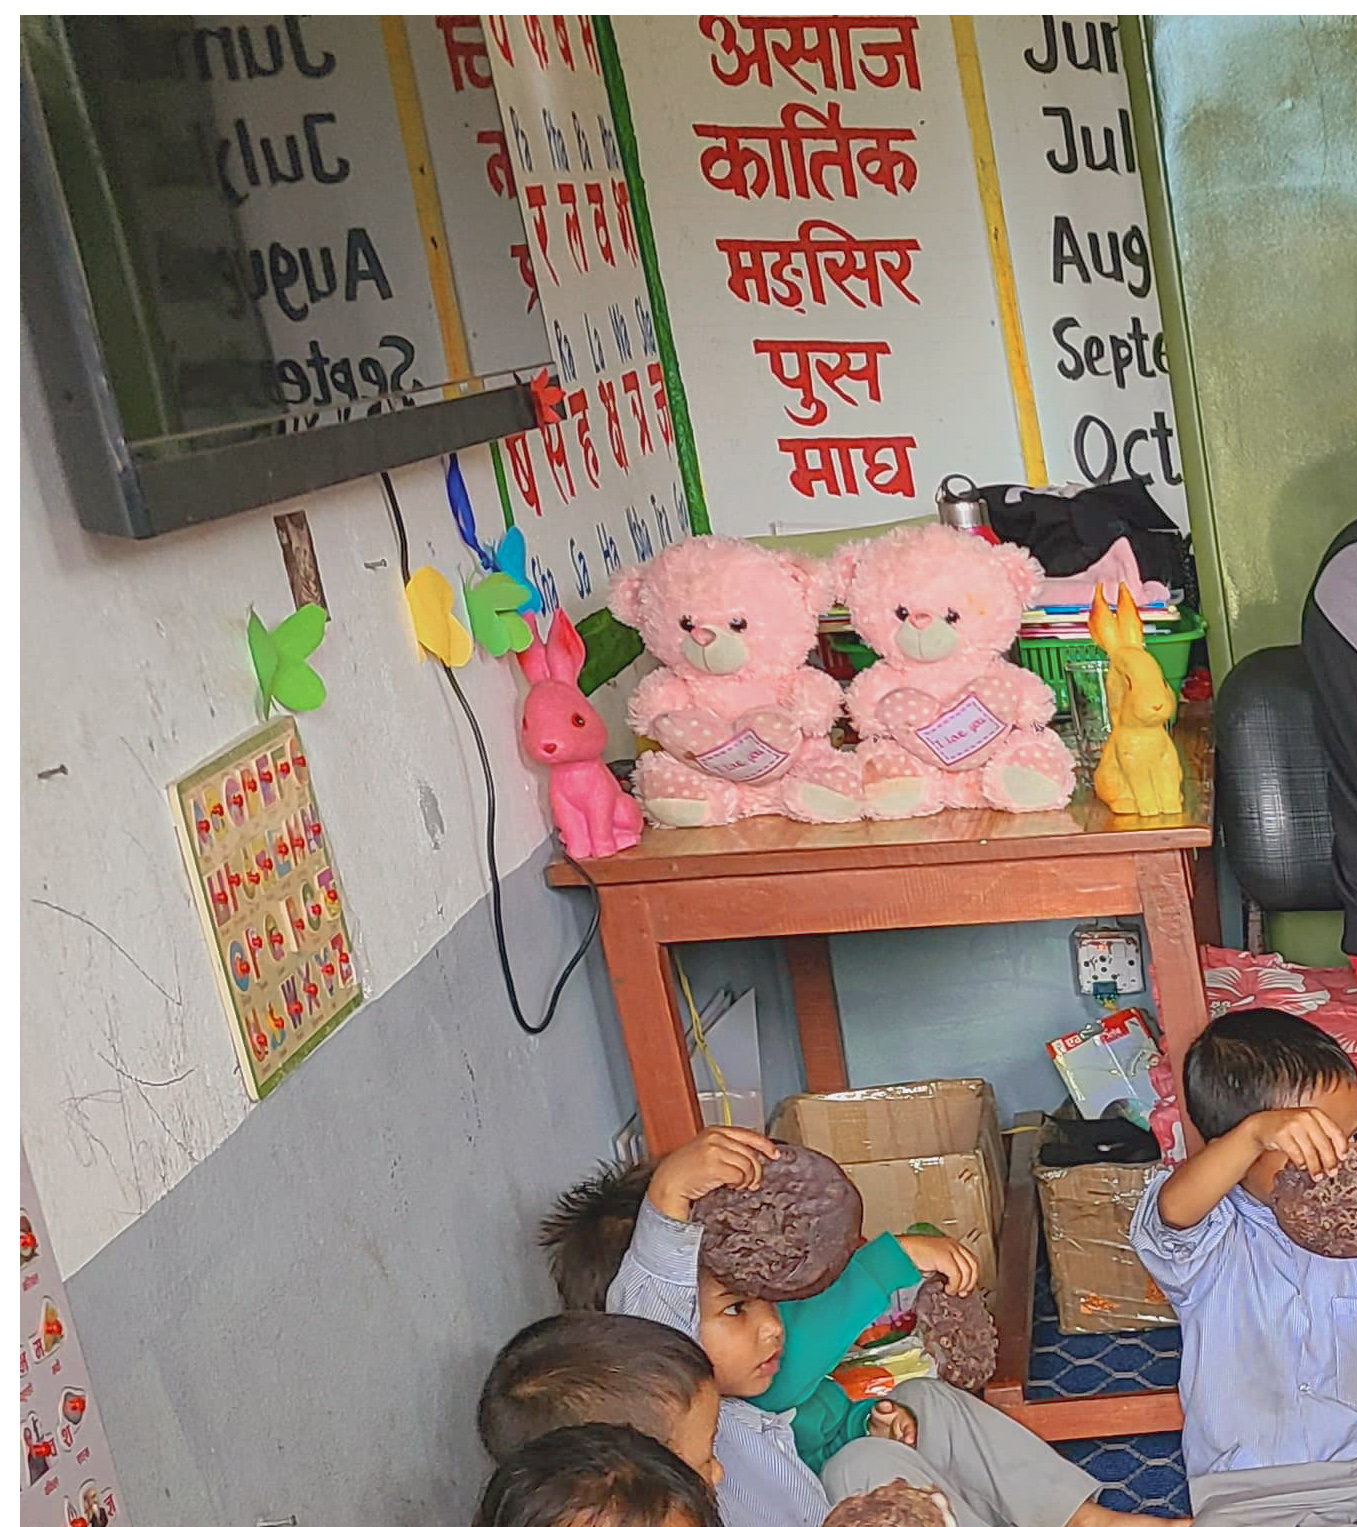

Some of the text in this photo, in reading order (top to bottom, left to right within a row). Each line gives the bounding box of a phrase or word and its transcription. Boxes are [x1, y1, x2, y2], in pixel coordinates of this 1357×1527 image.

[692, 102, 917, 201] कार्तिक
[1052, 215, 1150, 298] Aug
[753, 339, 892, 427] पुस
[778, 436, 917, 499] माघ
[1073, 411, 1182, 487] Oct
